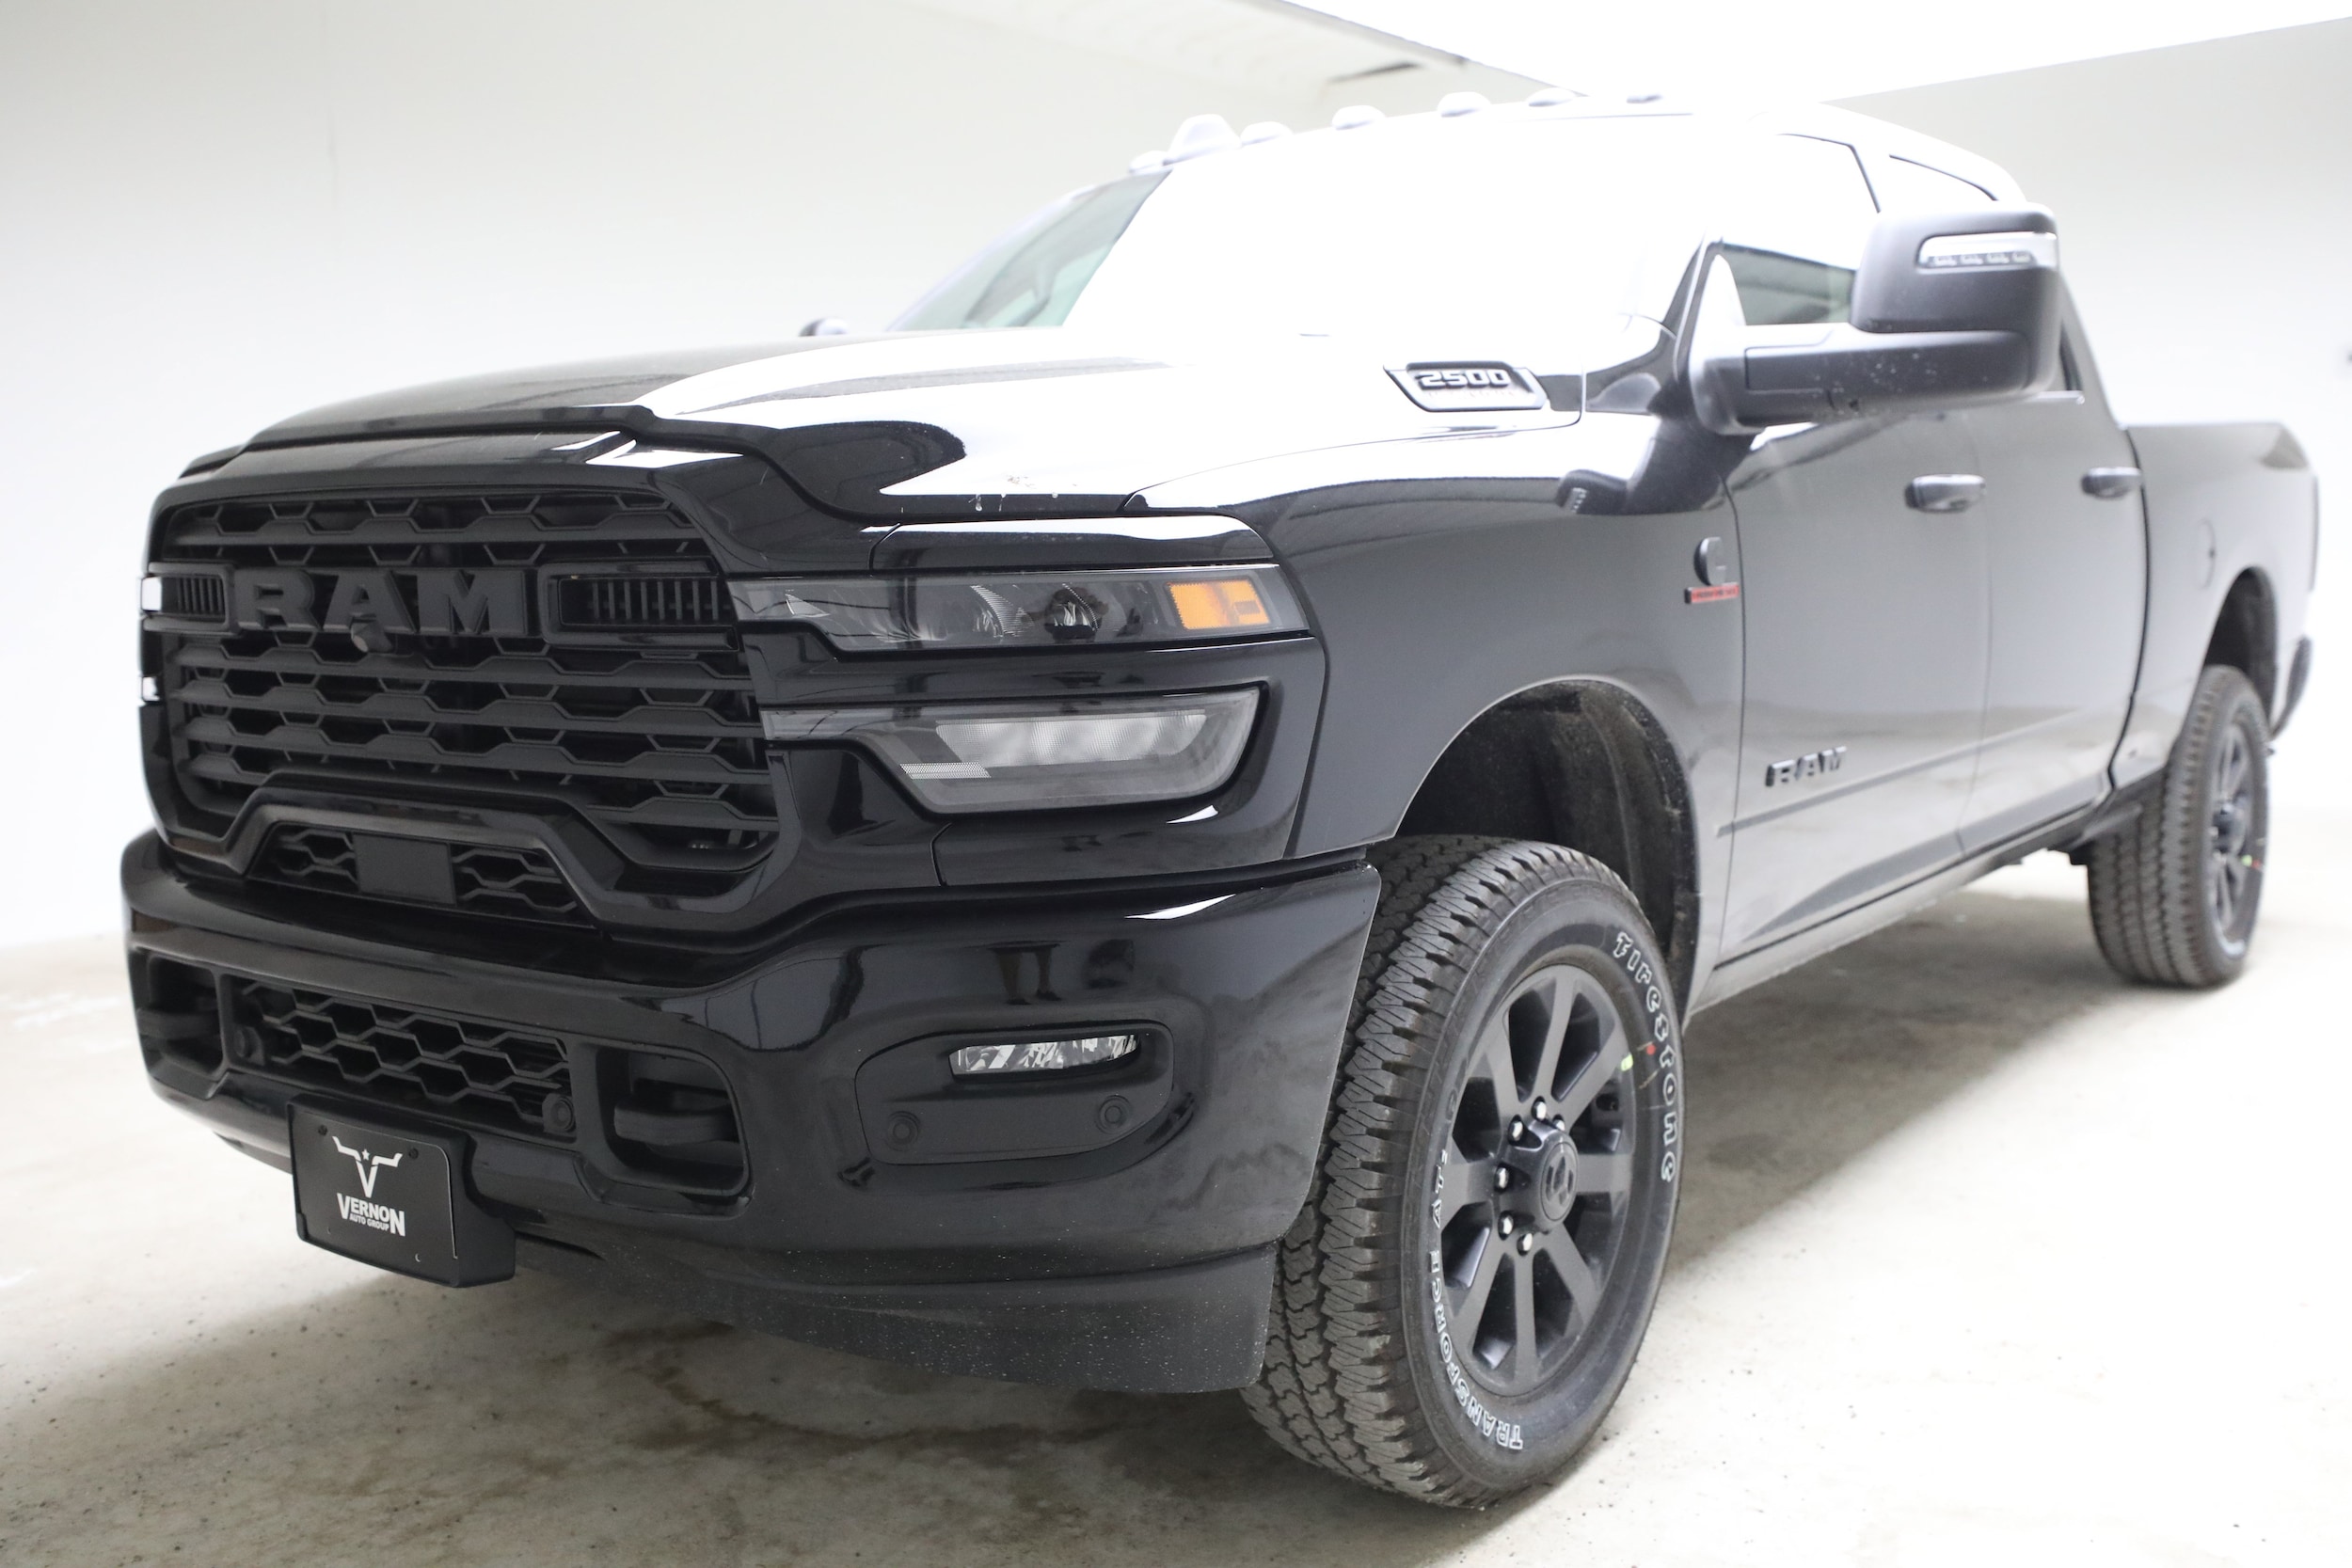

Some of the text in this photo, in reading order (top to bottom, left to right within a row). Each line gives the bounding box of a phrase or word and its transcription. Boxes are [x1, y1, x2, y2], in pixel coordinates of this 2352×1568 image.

[1418, 370, 1511, 389] 2500
[235, 568, 527, 637] RAM
[1764, 746, 1848, 787] RAM
[336, 1192, 406, 1237] VERNON
[349, 1213, 389, 1231] AUTO GROUP
[1429, 1249, 1524, 1450] TRANSFORCE
